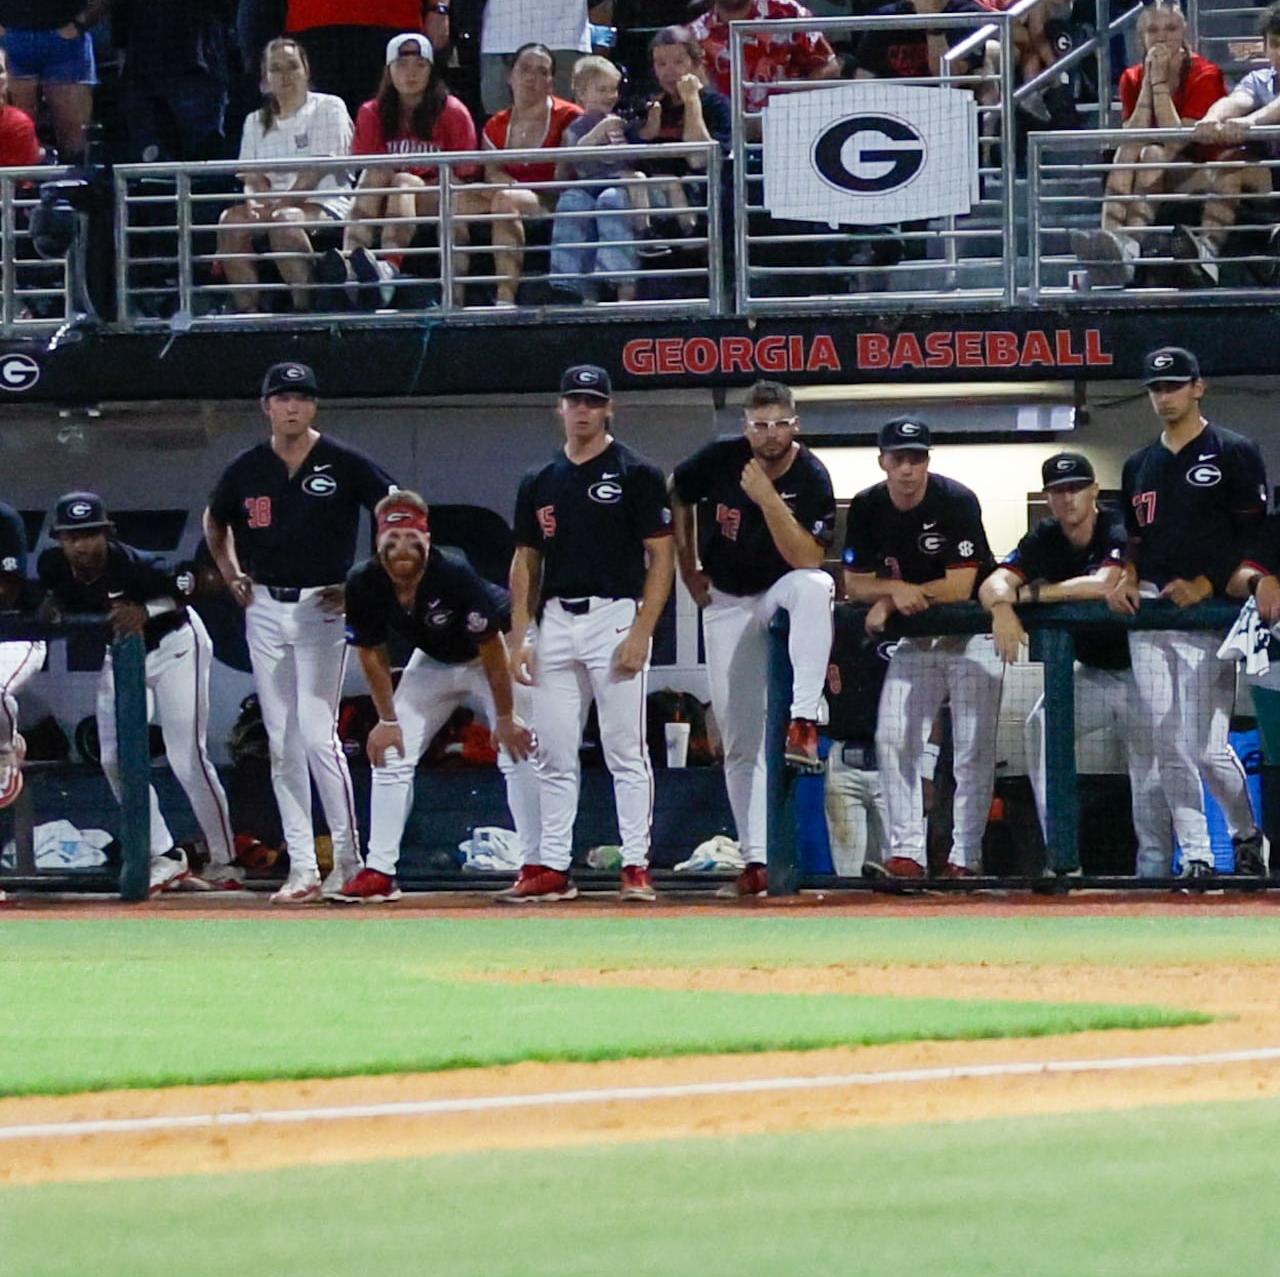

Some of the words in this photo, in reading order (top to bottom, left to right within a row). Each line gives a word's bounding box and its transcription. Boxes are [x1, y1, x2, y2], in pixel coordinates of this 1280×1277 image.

[813, 114, 927, 195] G
[0, 353, 40, 392] G
[622, 334, 841, 376] GEORGIA
[857, 329, 1113, 370] BASEBALL
